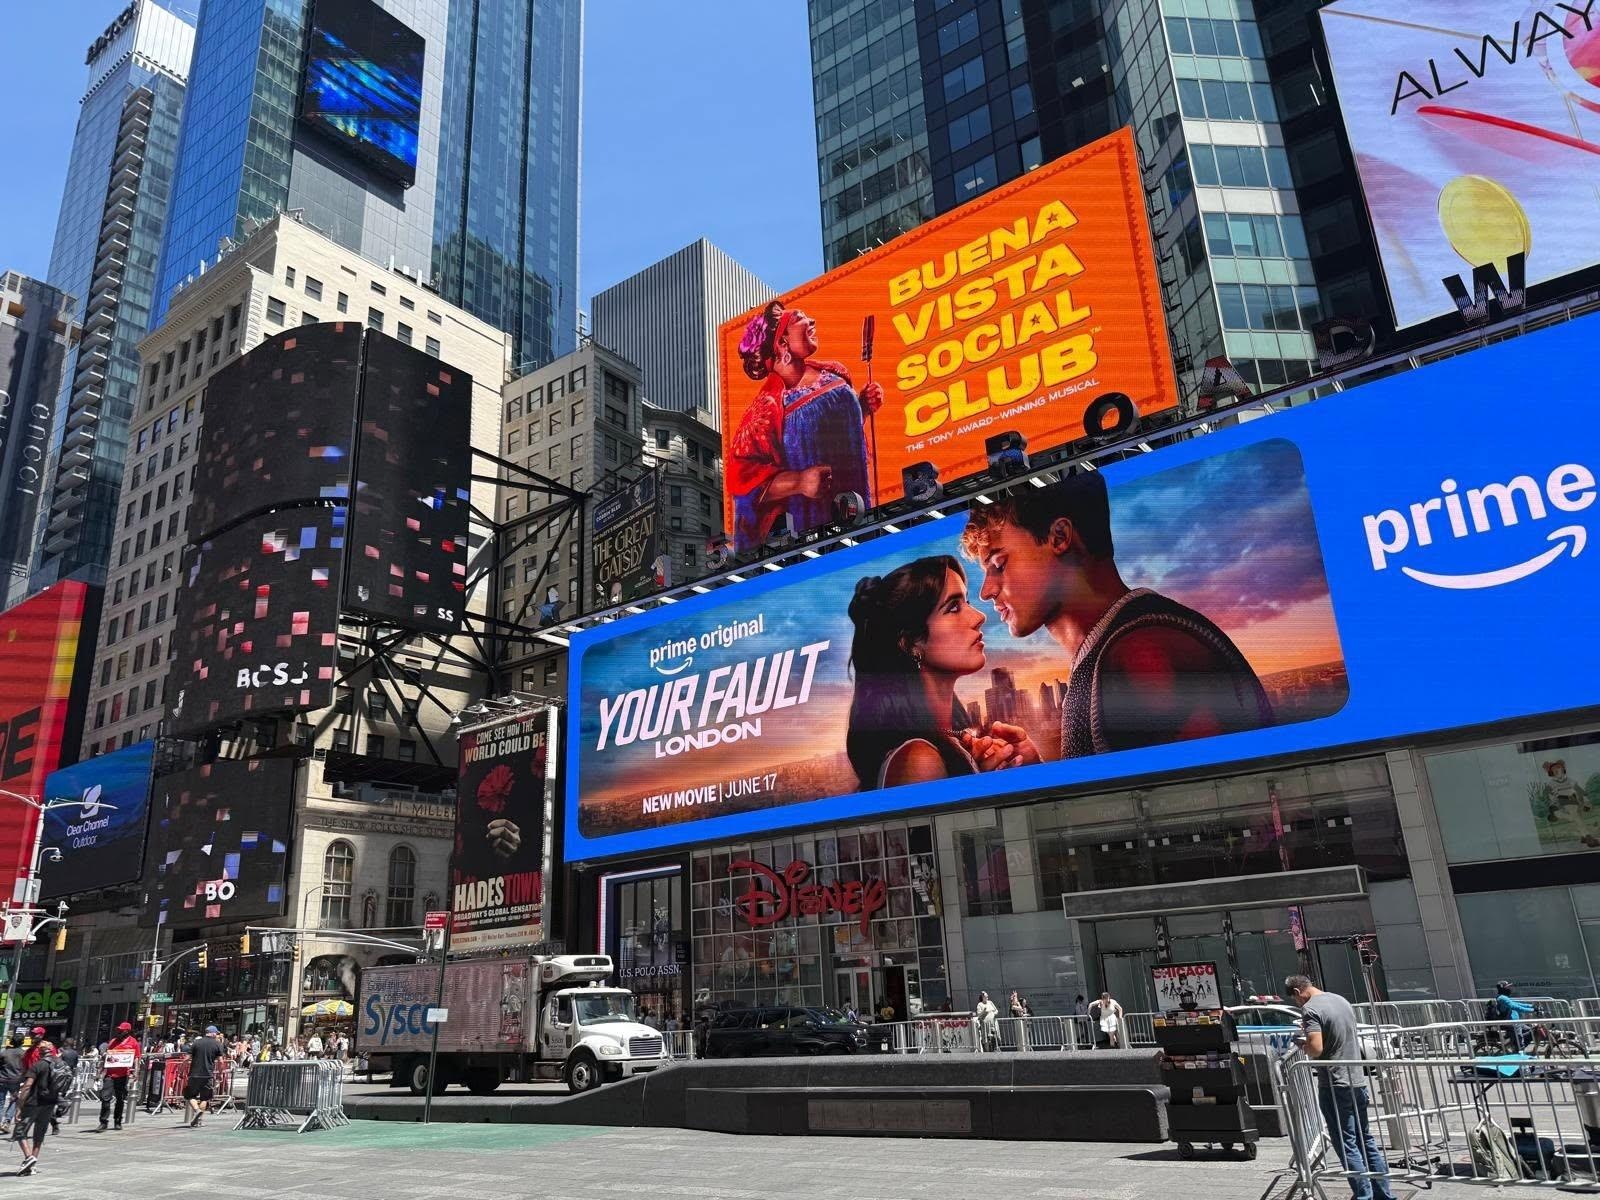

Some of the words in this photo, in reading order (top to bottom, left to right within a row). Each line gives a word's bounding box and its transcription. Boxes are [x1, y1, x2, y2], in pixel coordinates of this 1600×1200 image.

[888, 200, 1079, 306] BUENA
[892, 243, 1086, 346] VISTA
[896, 289, 1091, 391] SOCIAL
[903, 333, 1098, 437] CLUB
[906, 441, 925, 453] THE
[928, 431, 955, 444] TONY
[1049, 377, 1100, 401] MUSICAL
[16, 403, 50, 495] GUCCI
[592, 536, 613, 566] THE
[614, 511, 656, 552] GREAT
[1362, 463, 1597, 571] prime
[600, 538, 649, 583] GATSBY
[437, 607, 454, 622] SS
[650, 637, 697, 668] prime
[700, 613, 764, 648] original
[596, 673, 700, 751] YOUR
[697, 640, 830, 728] FAULT
[0, 706, 42, 782] E
[464, 742, 497, 763] WORLD
[498, 734, 530, 756] COULD
[532, 731, 546, 749] BE
[476, 729, 492, 745] COME
[493, 726, 506, 740] SEE
[507, 722, 521, 737] HOW
[522, 717, 535, 732] THE
[655, 717, 762, 759] LONDON
[642, 794, 673, 815] NEW
[674, 784, 717, 810] MOVIE
[724, 776, 761, 799] JUNE
[763, 773, 778, 792] 17
[66, 825, 84, 837] Clear
[84, 815, 110, 832] Channel
[72, 835, 98, 849] Outdoor
[204, 881, 235, 901] BO
[454, 871, 541, 912] HADESTOWN
[454, 909, 488, 921] BROADWAY'S
[488, 907, 509, 918] GLOBAL
[510, 903, 541, 914] SENSATIO
[727, 860, 887, 937] Disney
[619, 968, 634, 978] U.S.
[635, 966, 656, 977] POLO
[658, 964, 682, 976] ASSN.
[1152, 964, 1215, 979] CHICAGO
